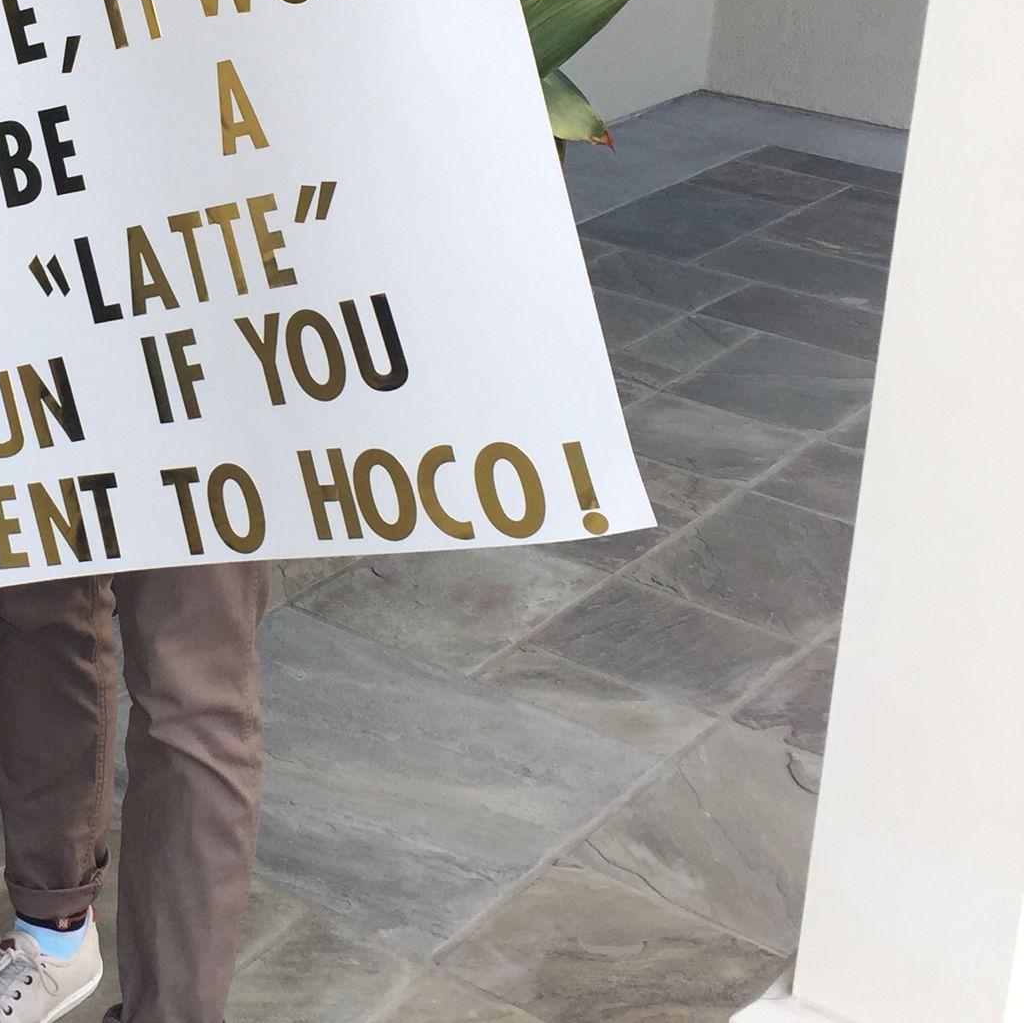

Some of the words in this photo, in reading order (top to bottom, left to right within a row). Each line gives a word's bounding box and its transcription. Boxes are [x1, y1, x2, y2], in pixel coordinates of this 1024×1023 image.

[217, 59, 270, 157] A
[140, 327, 206, 425] IF
[233, 292, 410, 407] YOU
[159, 463, 266, 556] TO
